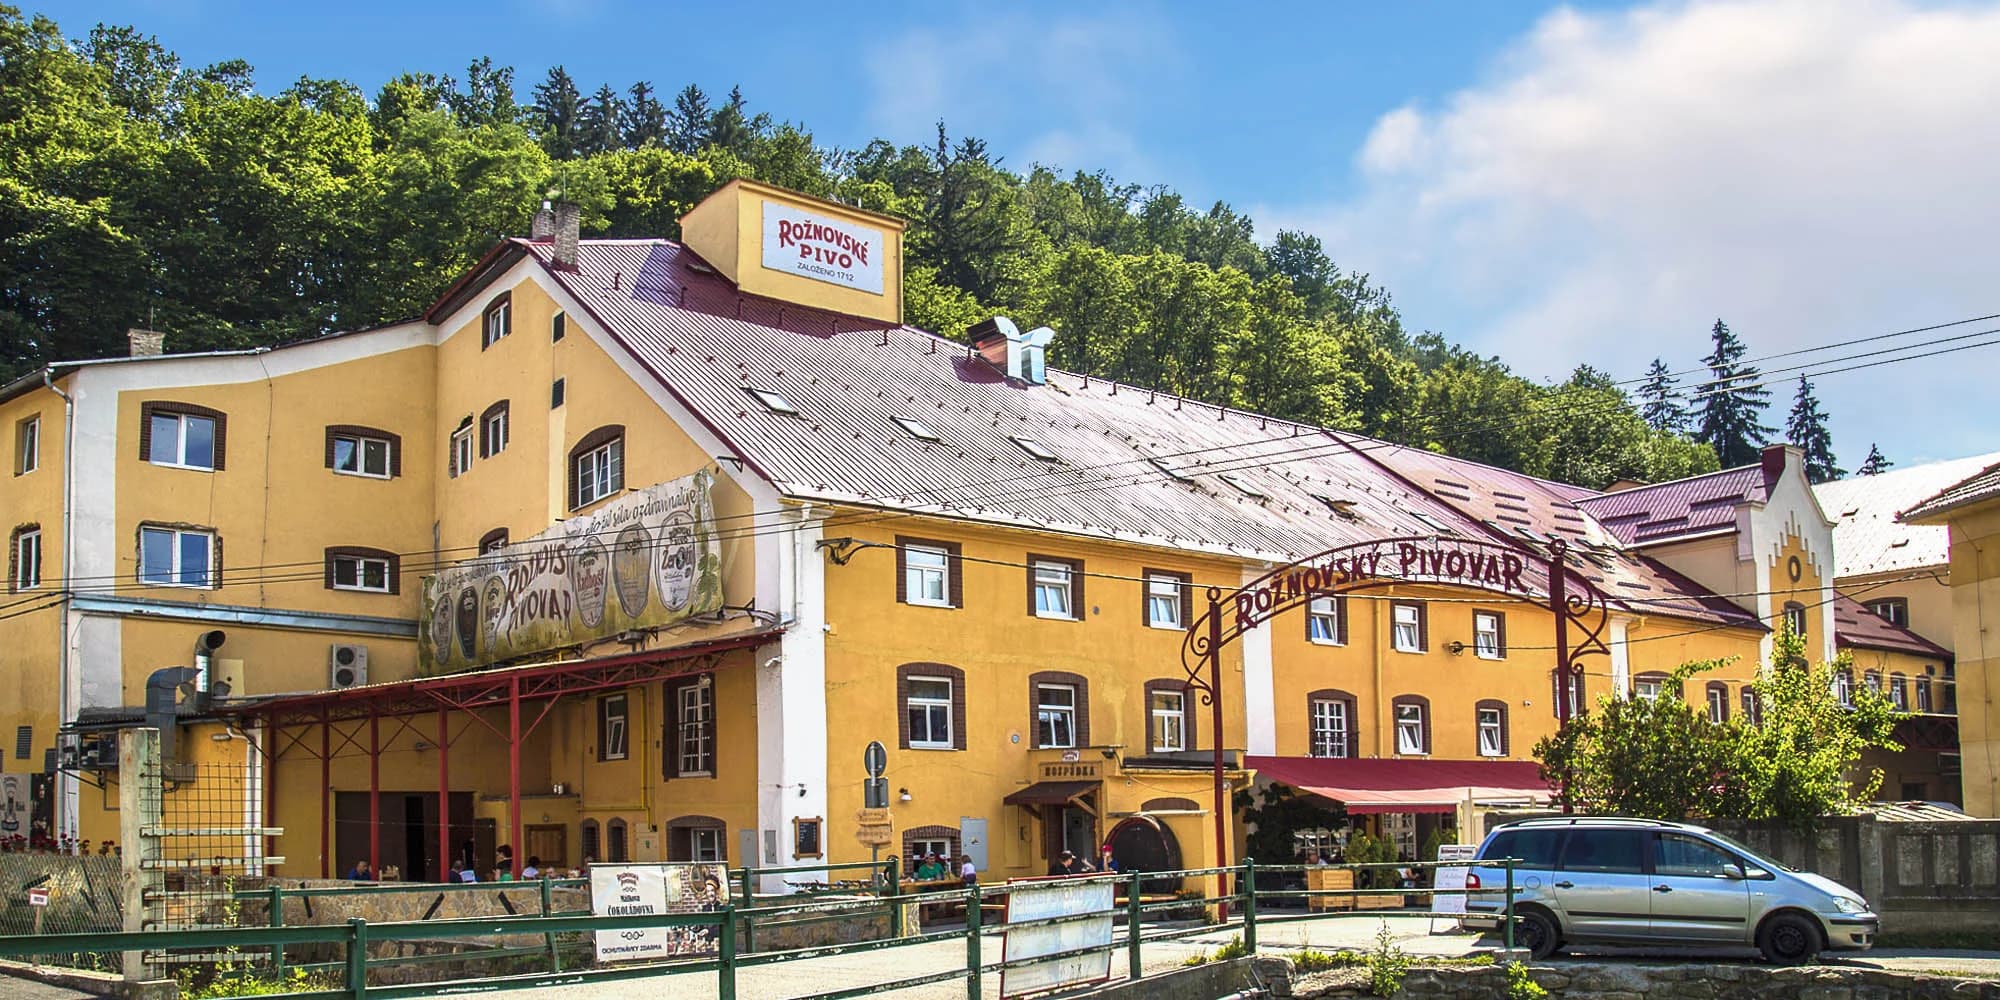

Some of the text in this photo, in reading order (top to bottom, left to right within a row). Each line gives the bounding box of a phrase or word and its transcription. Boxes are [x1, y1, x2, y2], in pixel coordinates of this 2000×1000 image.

[778, 219, 868, 267] ROŽNOVSKÉ
[800, 243, 853, 269] PIVO
[797, 262, 854, 281] ZALOŽENO 1712
[1235, 543, 1529, 634] ROŽNOVSKÝ PIVOVAR
